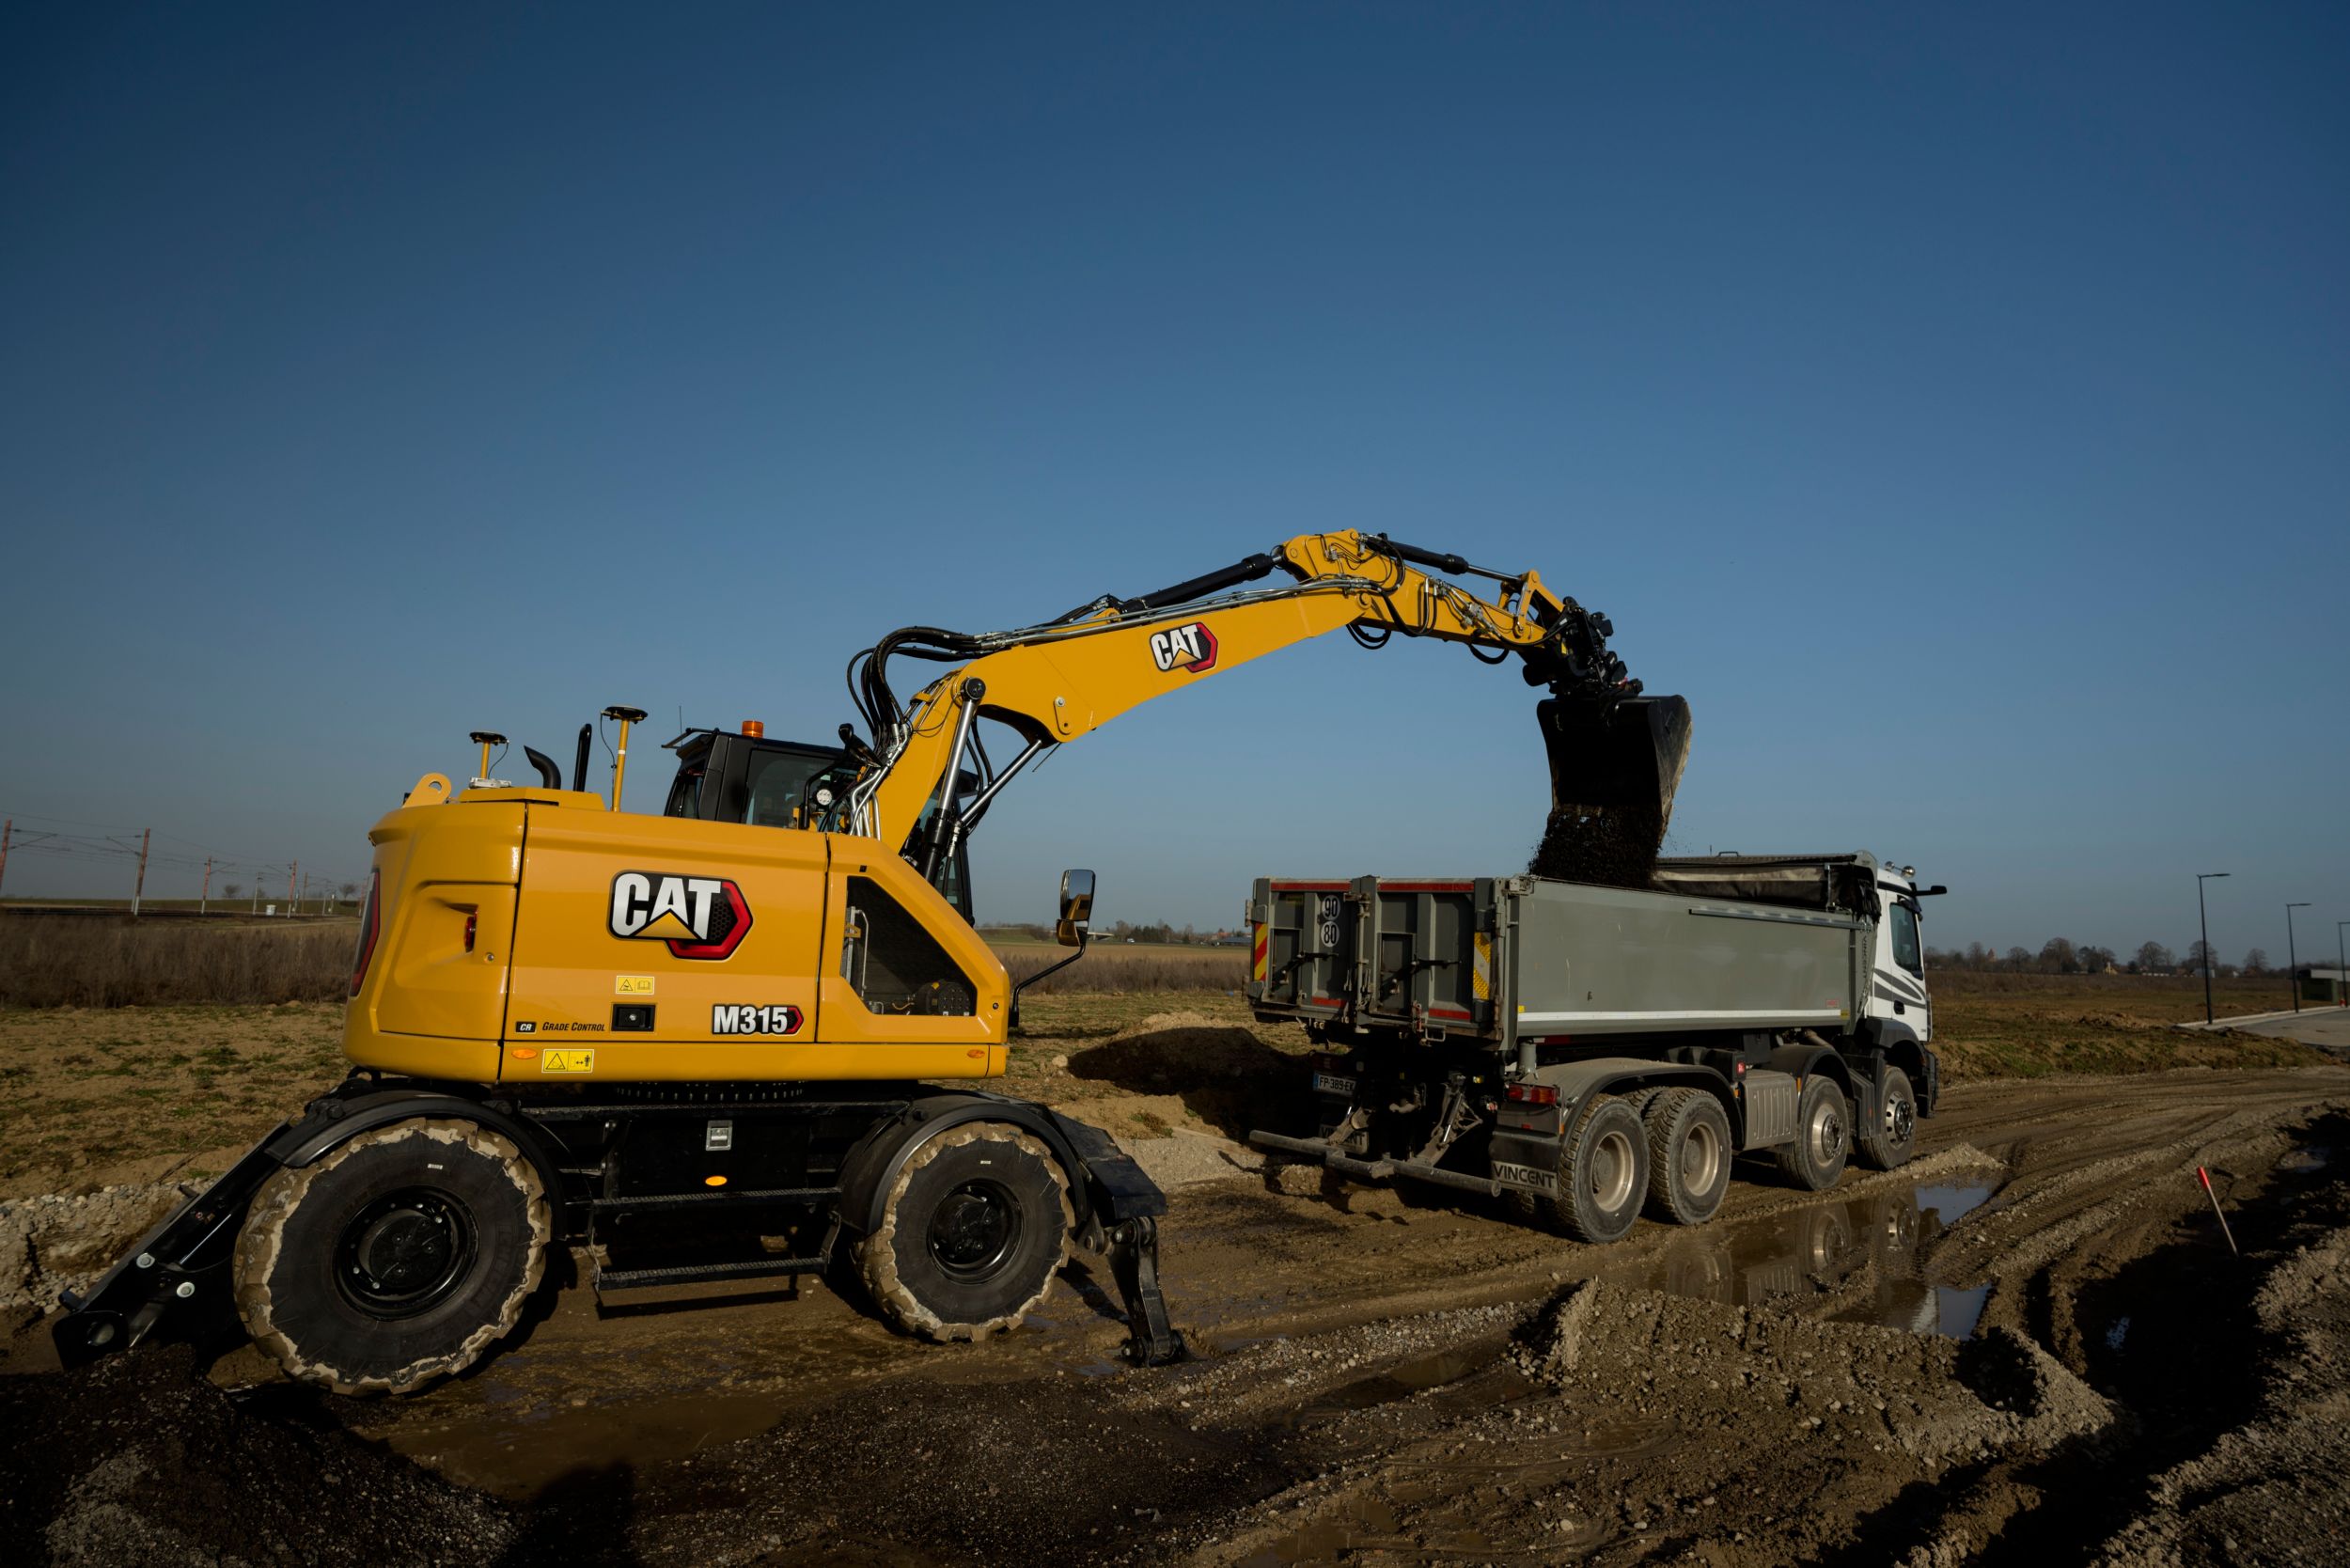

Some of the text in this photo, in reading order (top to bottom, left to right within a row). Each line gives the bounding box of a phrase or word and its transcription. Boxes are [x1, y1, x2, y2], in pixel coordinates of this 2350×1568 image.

[1151, 623, 1203, 670] CAT
[612, 872, 721, 939] CAT
[1324, 898, 1339, 917] 90
[1324, 925, 1338, 944] 80
[519, 1022, 605, 1032] CR GRADE CONTROL
[713, 1005, 789, 1034] M315
[1493, 1163, 1555, 1188] VINCENT
